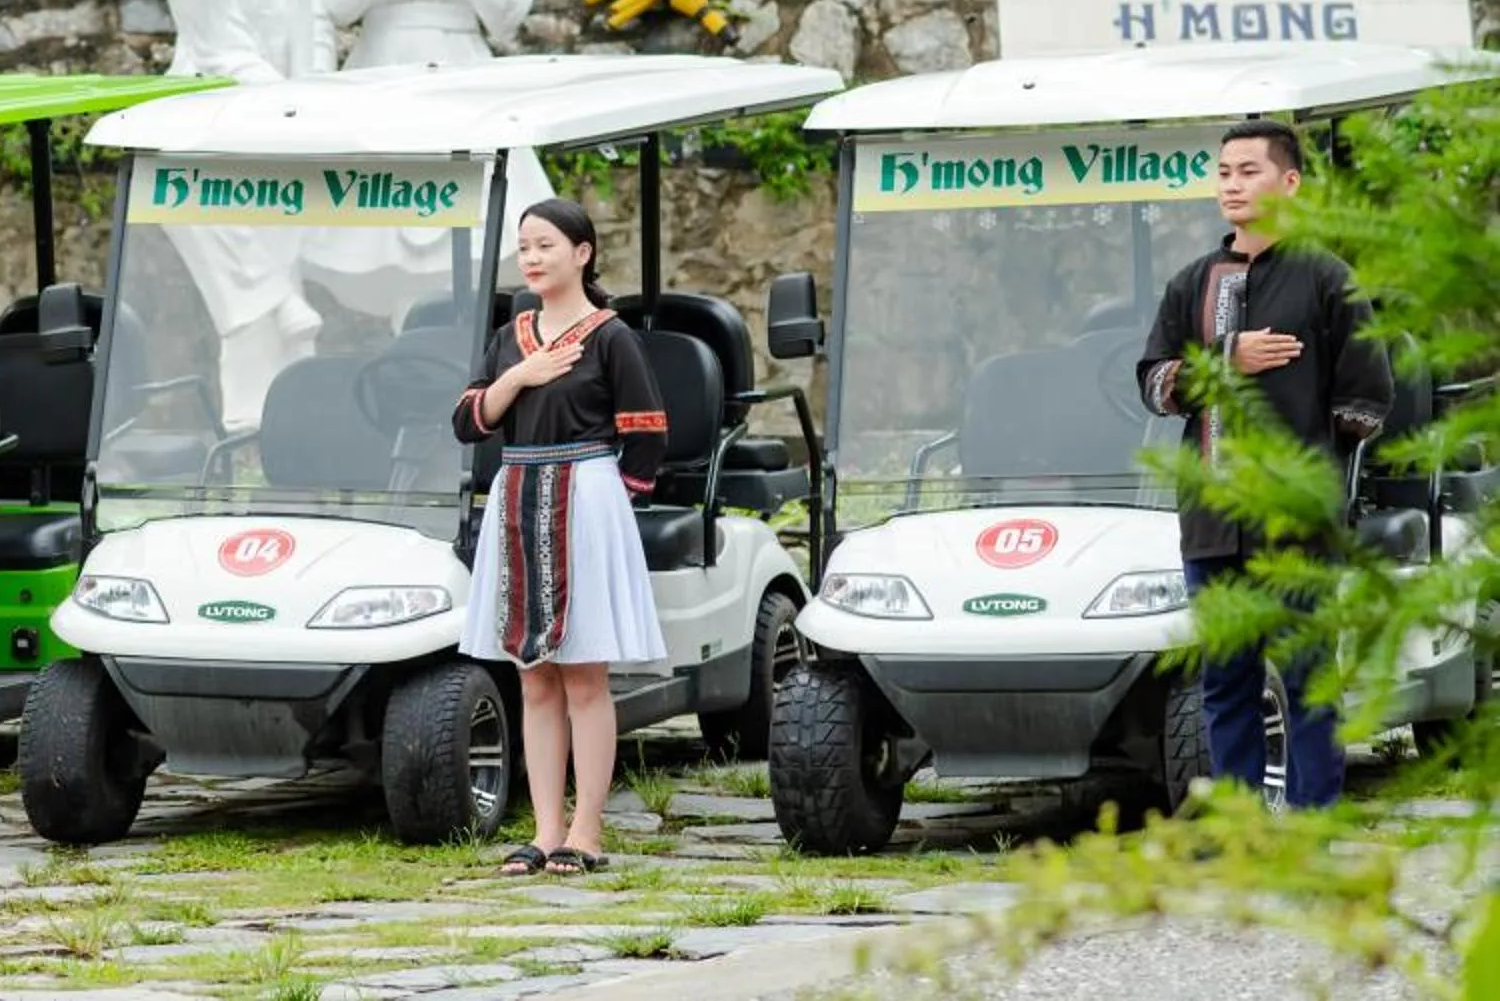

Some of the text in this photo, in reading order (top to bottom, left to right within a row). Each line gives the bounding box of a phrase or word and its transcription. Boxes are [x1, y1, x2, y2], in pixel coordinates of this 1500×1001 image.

[880, 145, 1211, 194] H'mong Village
[153, 168, 459, 217] H'mong Village
[234, 536, 280, 562] 04
[995, 528, 1046, 555] 05
[205, 605, 269, 618] LVTONG
[971, 600, 1040, 612] LVTONG
